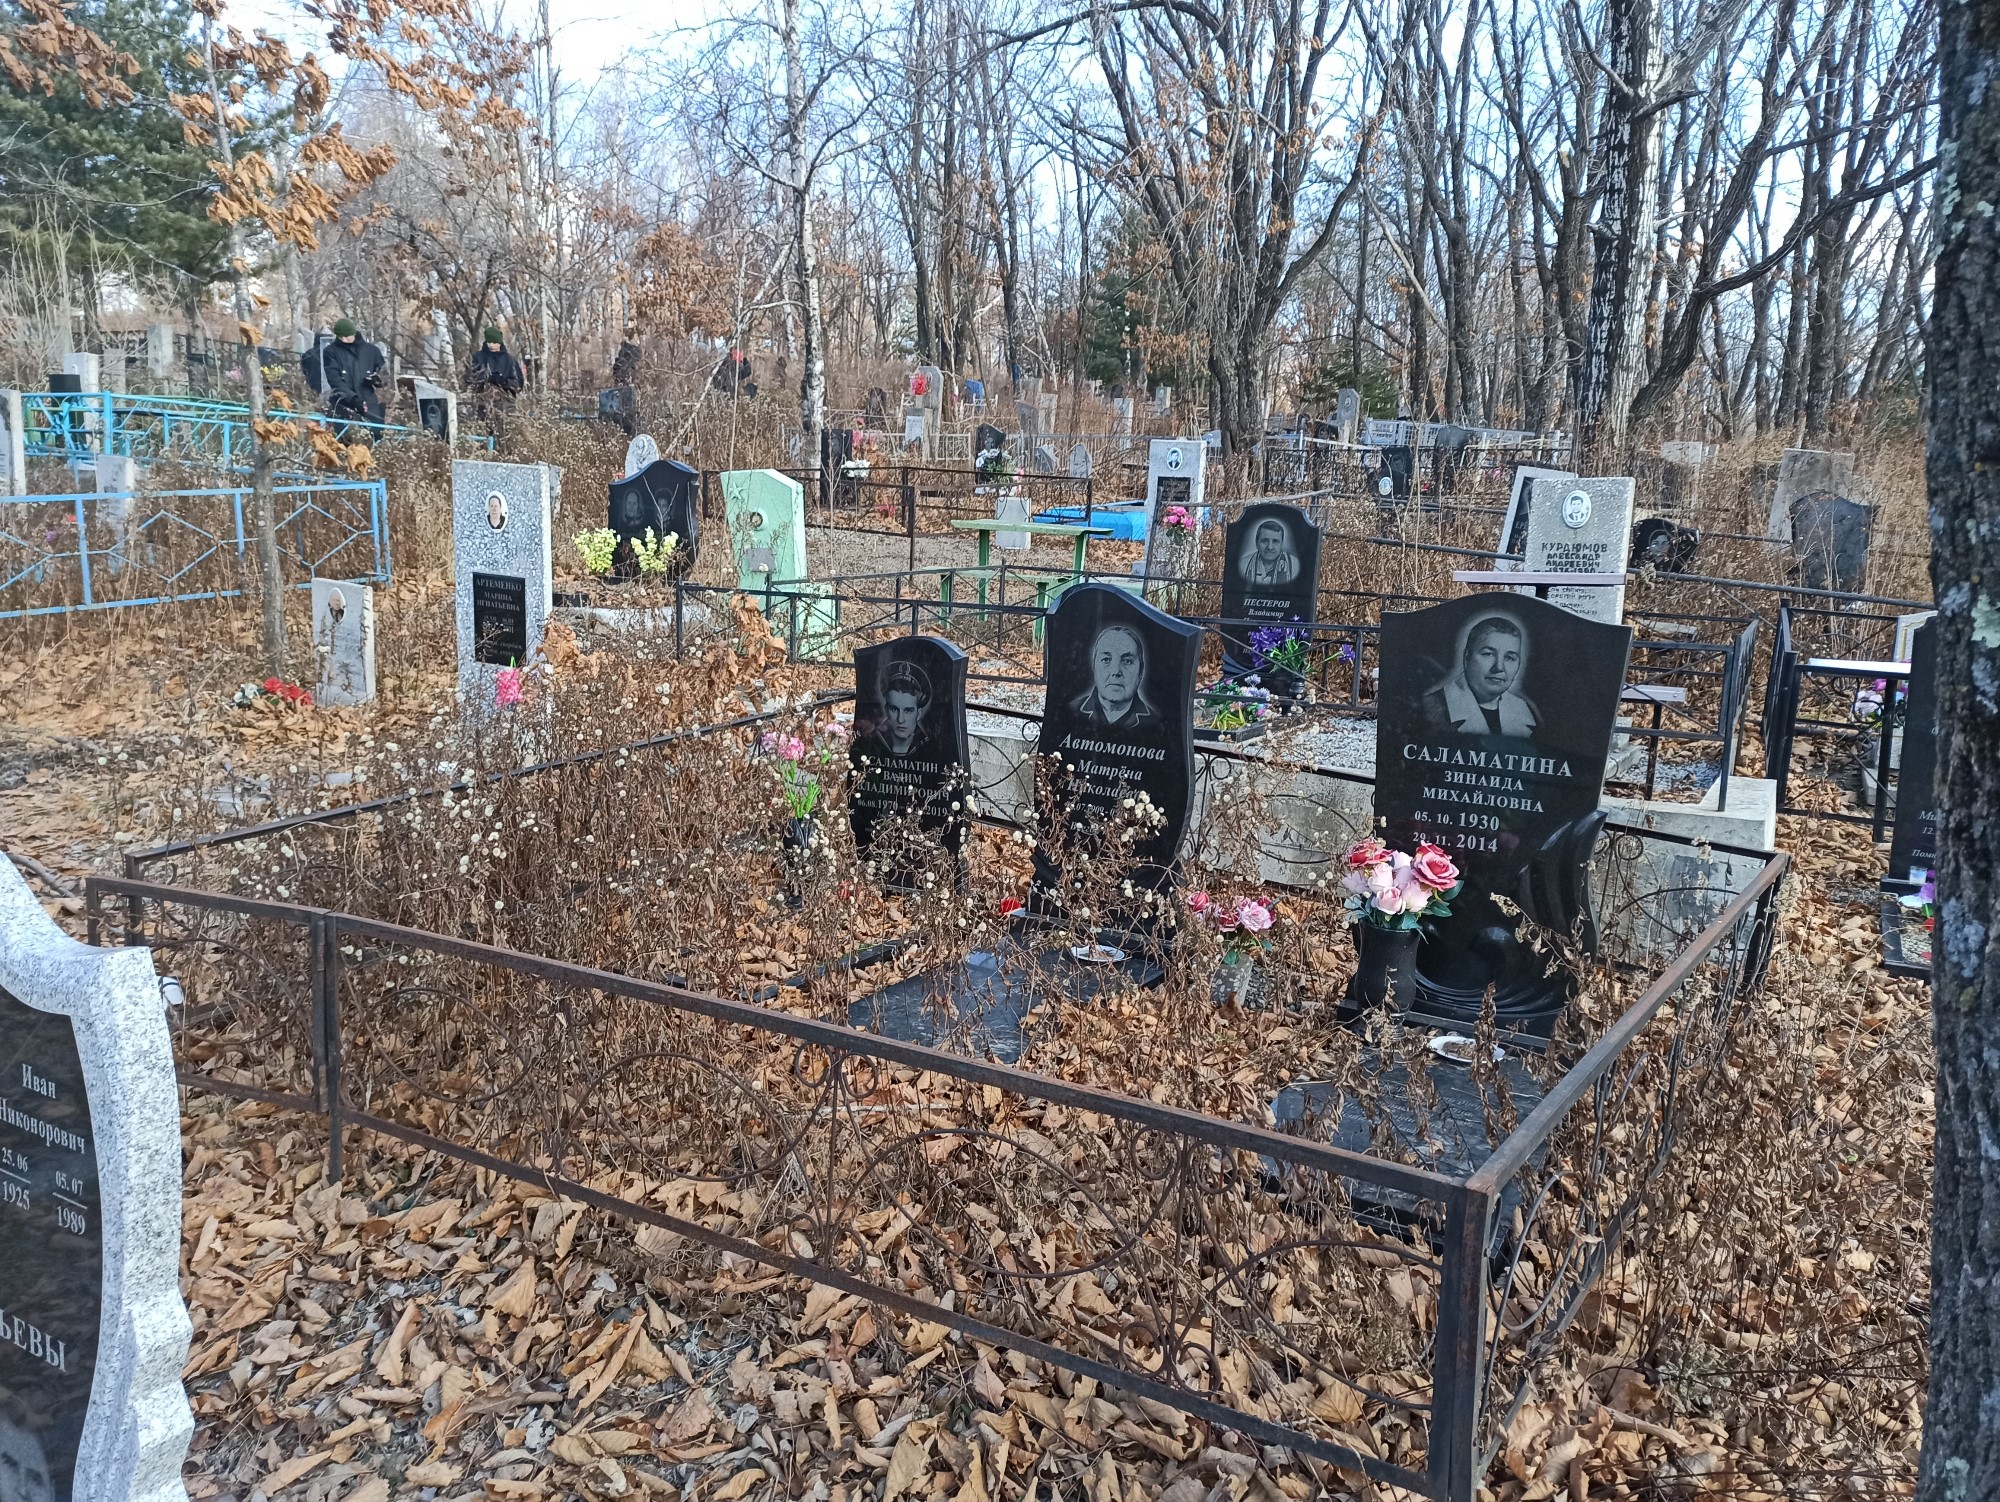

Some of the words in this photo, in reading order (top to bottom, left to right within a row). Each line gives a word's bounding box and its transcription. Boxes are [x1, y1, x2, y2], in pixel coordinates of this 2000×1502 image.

[1541, 542, 1608, 553] КУРДЮМОВ
[475, 578, 522, 591] АРТЕМЕНКО
[476, 600, 521, 612] ИГНАТЬЕВНА
[484, 591, 513, 602] МАРИНА
[1248, 609, 1285, 618] Владимир
[1059, 733, 1166, 761] Автомонова
[867, 755, 938, 773] САЛАМАТИН
[1077, 759, 1143, 781] Матрёна
[1403, 744, 1573, 777] САЛАМАТИНА
[1444, 771, 1524, 791] ЗИНАИДА
[1423, 787, 1544, 813] МИХАЙЛОВНА
[1459, 812, 1500, 831] 1930
[1456, 834, 1498, 853] 2014
[21, 1063, 57, 1100] Иван
[2, 1180, 30, 1211] 1925
[56, 1205, 86, 1236] 1989
